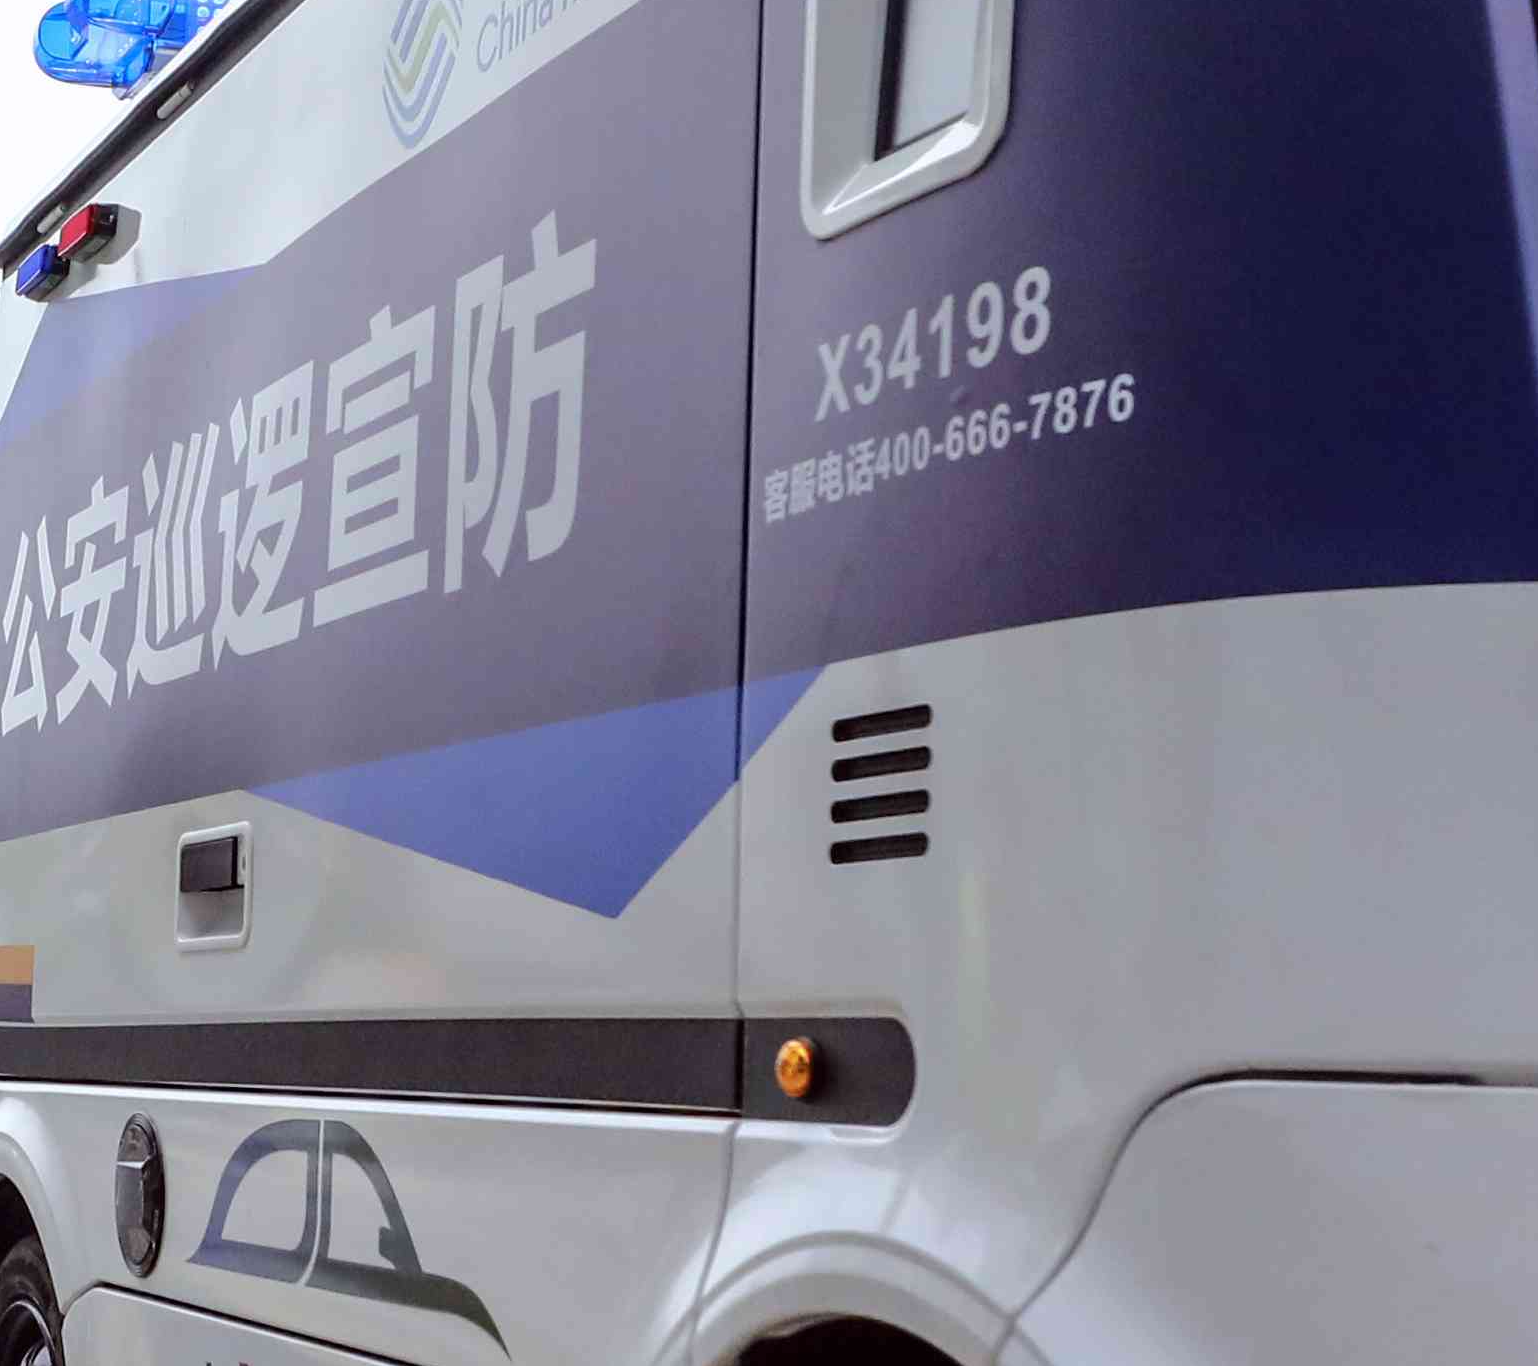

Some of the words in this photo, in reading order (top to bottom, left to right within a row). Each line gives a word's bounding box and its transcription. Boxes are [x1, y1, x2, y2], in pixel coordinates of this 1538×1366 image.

[814, 265, 1052, 423] X34198
[0, 208, 598, 737] 公安巡逻宣防
[762, 372, 1136, 525] 客服电话400-666-7876
